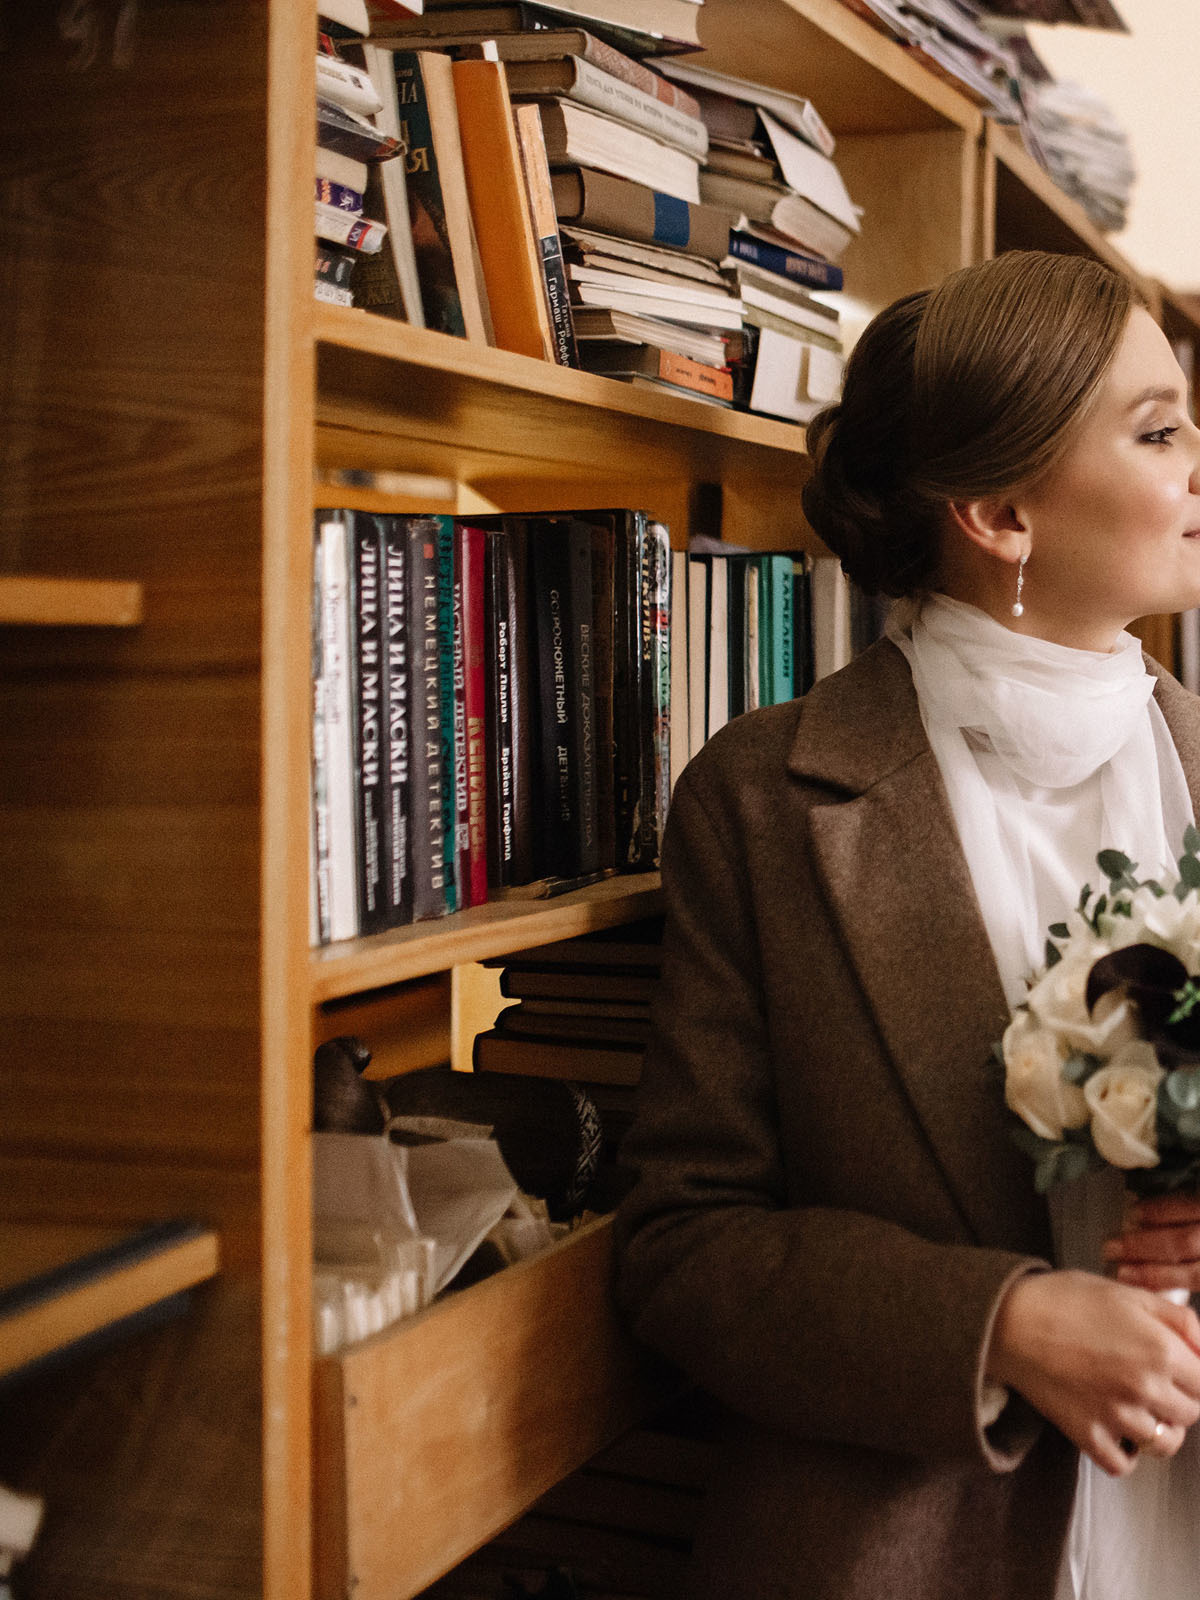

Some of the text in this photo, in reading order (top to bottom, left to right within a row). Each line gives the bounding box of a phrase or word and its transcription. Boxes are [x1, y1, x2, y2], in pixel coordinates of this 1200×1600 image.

[359, 538, 379, 635] ЛИЦА
[361, 639, 378, 665] И
[386, 544, 408, 785] ЛИЦА И МАСКИ
[497, 621, 508, 670] Роберт
[361, 671, 379, 786] МАСКИ
[424, 575, 444, 890] НЕМЕЦКИЙ ДЕТЕКТИВ
[454, 698, 468, 811] ДЕТЕКТИВ
[580, 623, 593, 848] ВЕСКИЕ ДОКАЗАТЕЛЬСТВА
[501, 803, 513, 862] Гарфилд
[556, 745, 571, 822] ДЕТЕИВ
